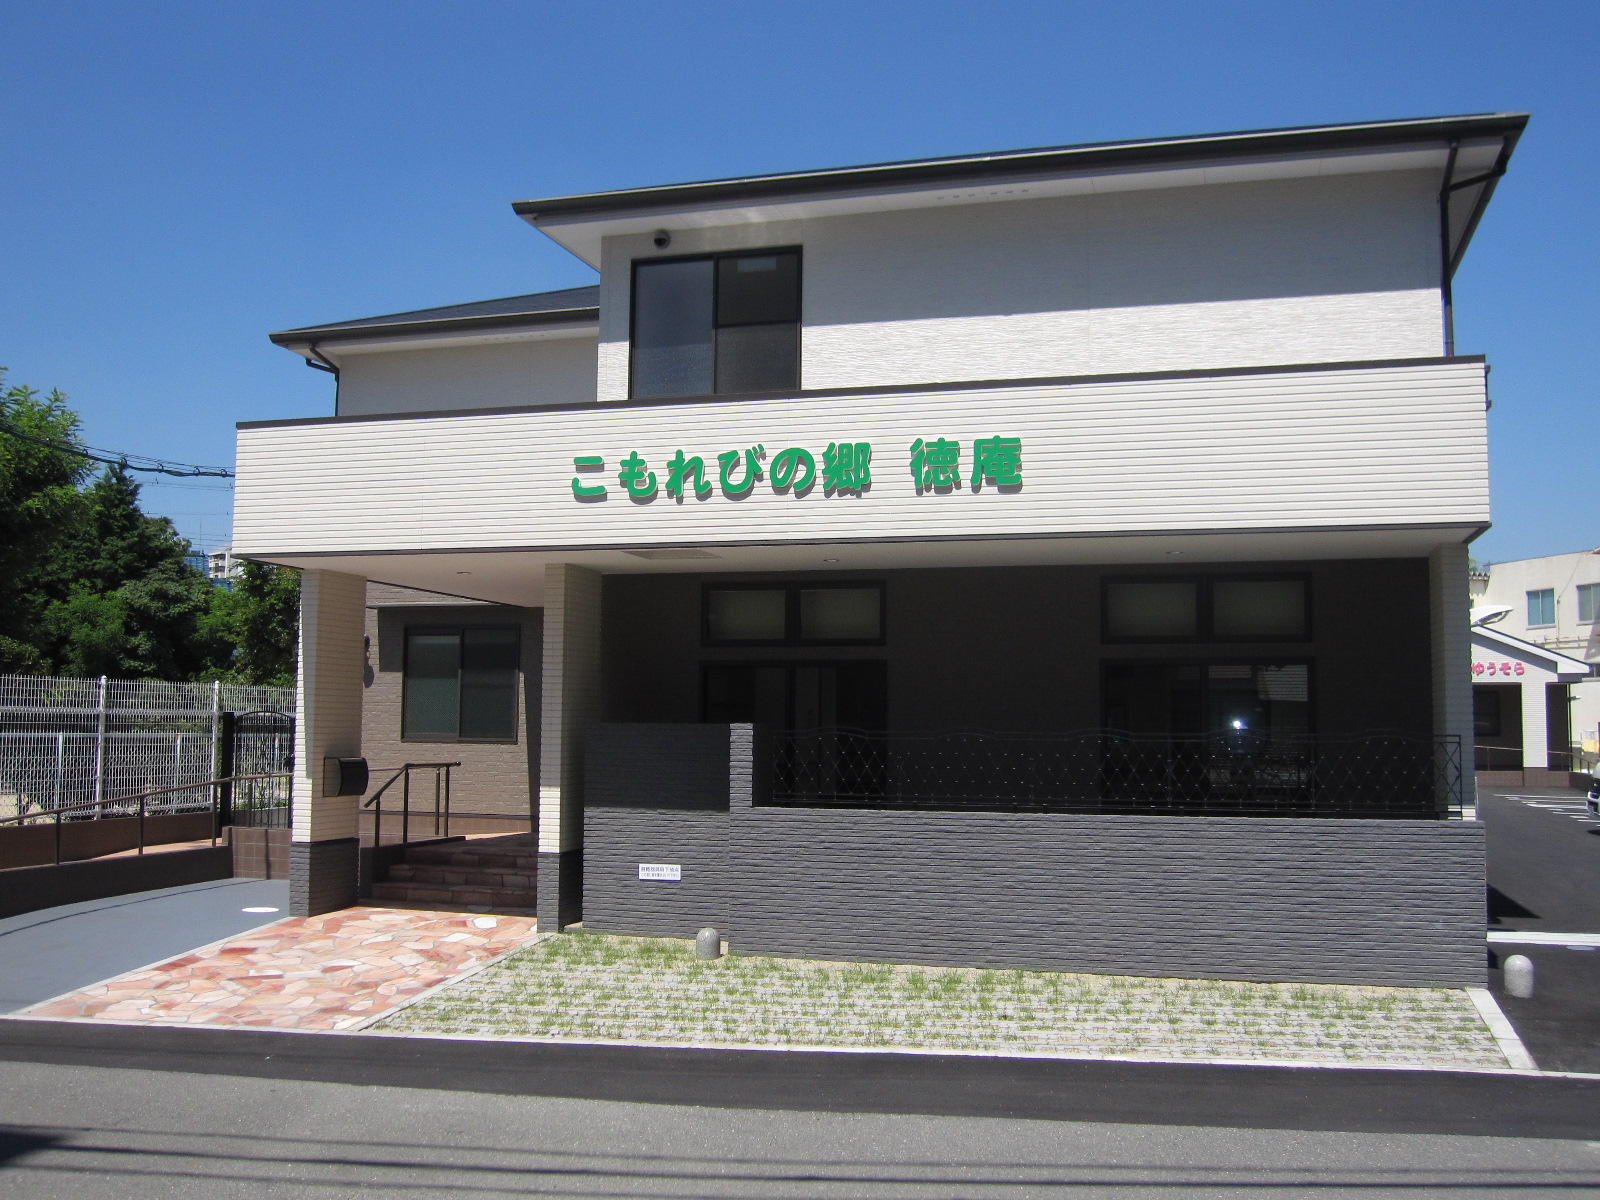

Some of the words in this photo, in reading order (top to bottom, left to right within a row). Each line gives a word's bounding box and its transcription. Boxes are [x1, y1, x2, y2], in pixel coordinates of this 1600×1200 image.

[571, 443, 872, 499] こもれびの郷
[909, 435, 1023, 489] 徳庵
